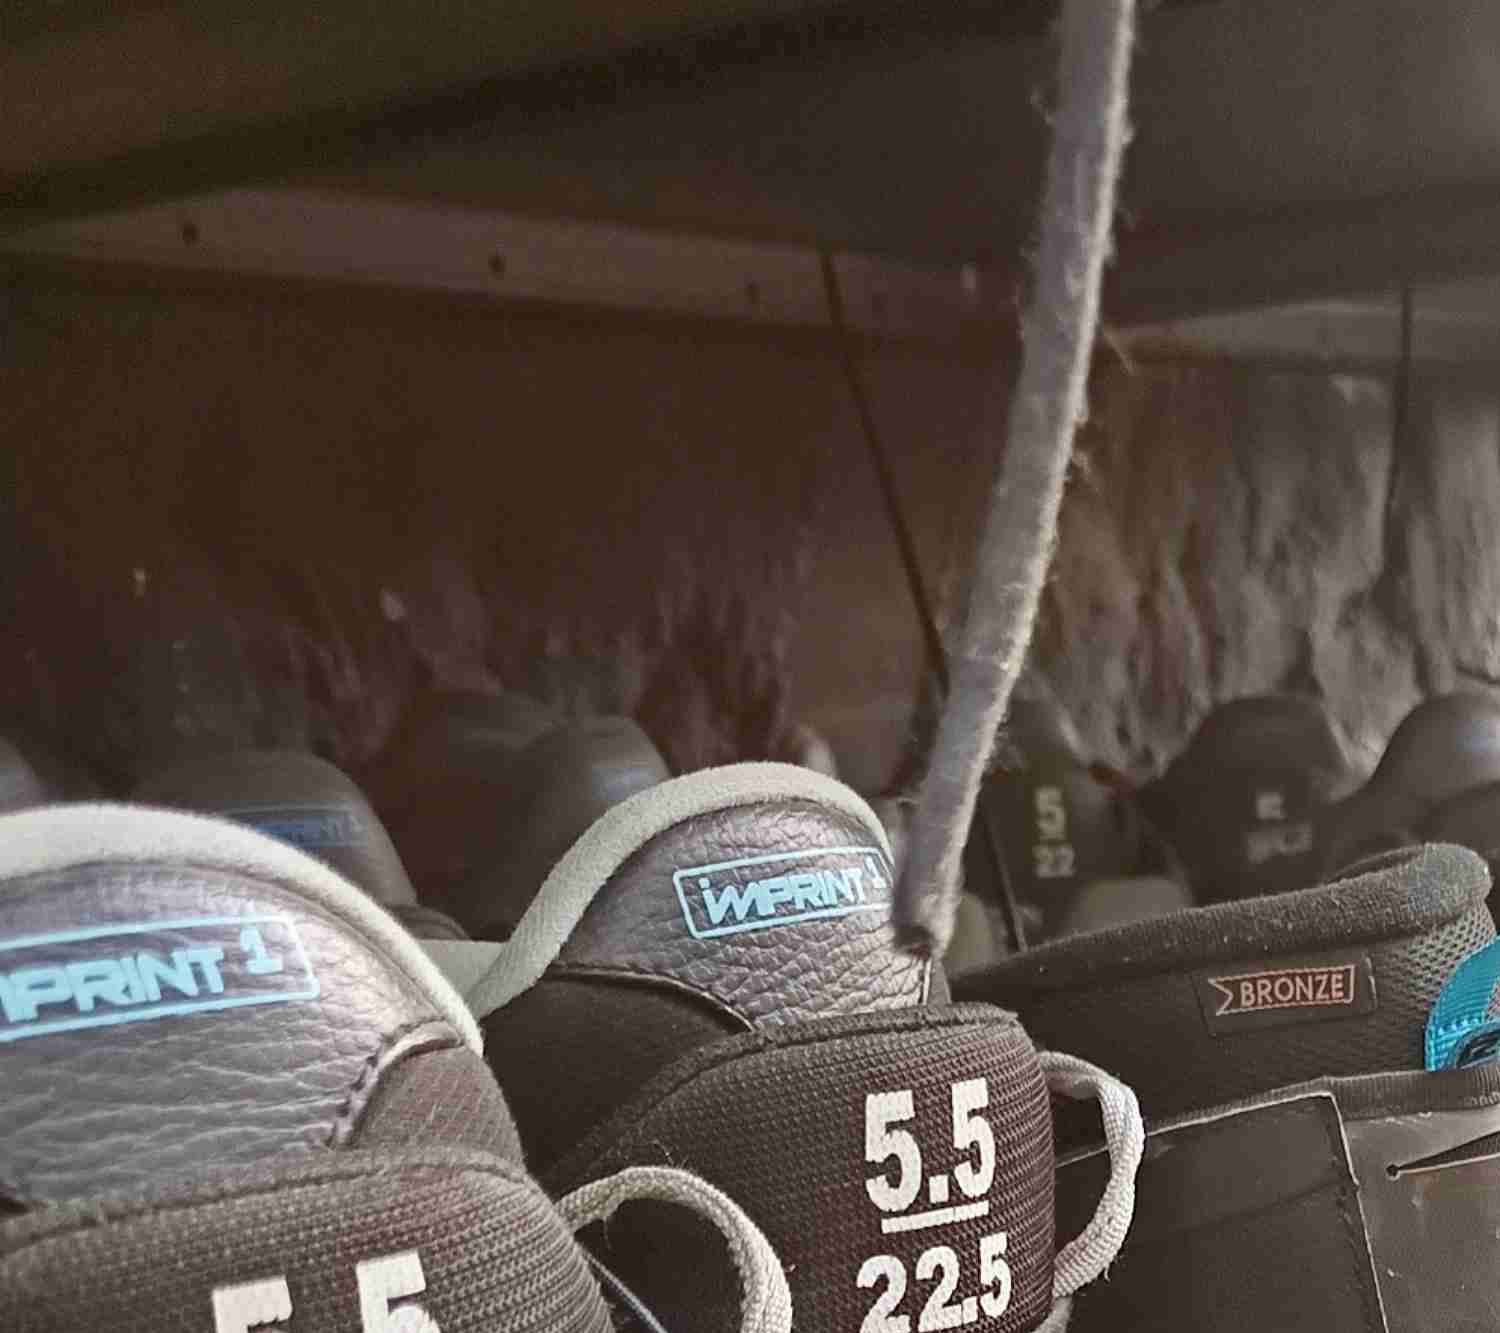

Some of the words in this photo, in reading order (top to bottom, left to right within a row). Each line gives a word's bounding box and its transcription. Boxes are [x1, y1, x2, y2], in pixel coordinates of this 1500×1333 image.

[0, 945, 224, 1023] PRINT
[240, 926, 284, 975] 1
[1240, 973, 1345, 1006] BRONZE
[864, 1076, 998, 1213] 5.5
